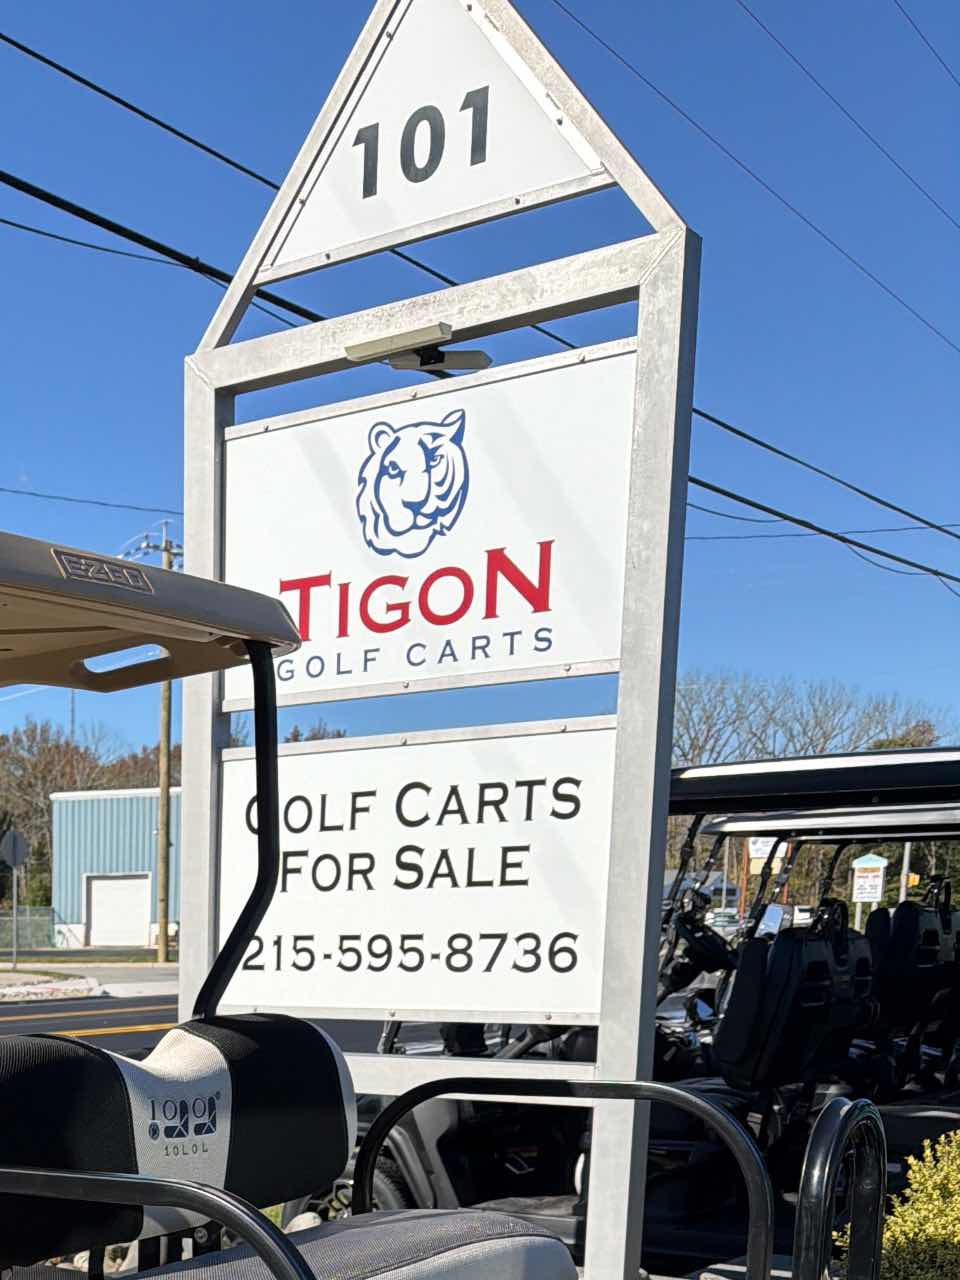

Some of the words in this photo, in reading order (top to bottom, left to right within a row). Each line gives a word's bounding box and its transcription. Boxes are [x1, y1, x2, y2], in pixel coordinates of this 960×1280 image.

[352, 84, 490, 200] 101
[279, 539, 556, 642] TIGON
[277, 647, 381, 682] GOLF
[406, 627, 554, 667] CARTS
[395, 776, 583, 828] CARTS
[280, 849, 376, 893] FOR
[393, 844, 532, 890] SALE
[240, 931, 580, 974] 215-595-8736
